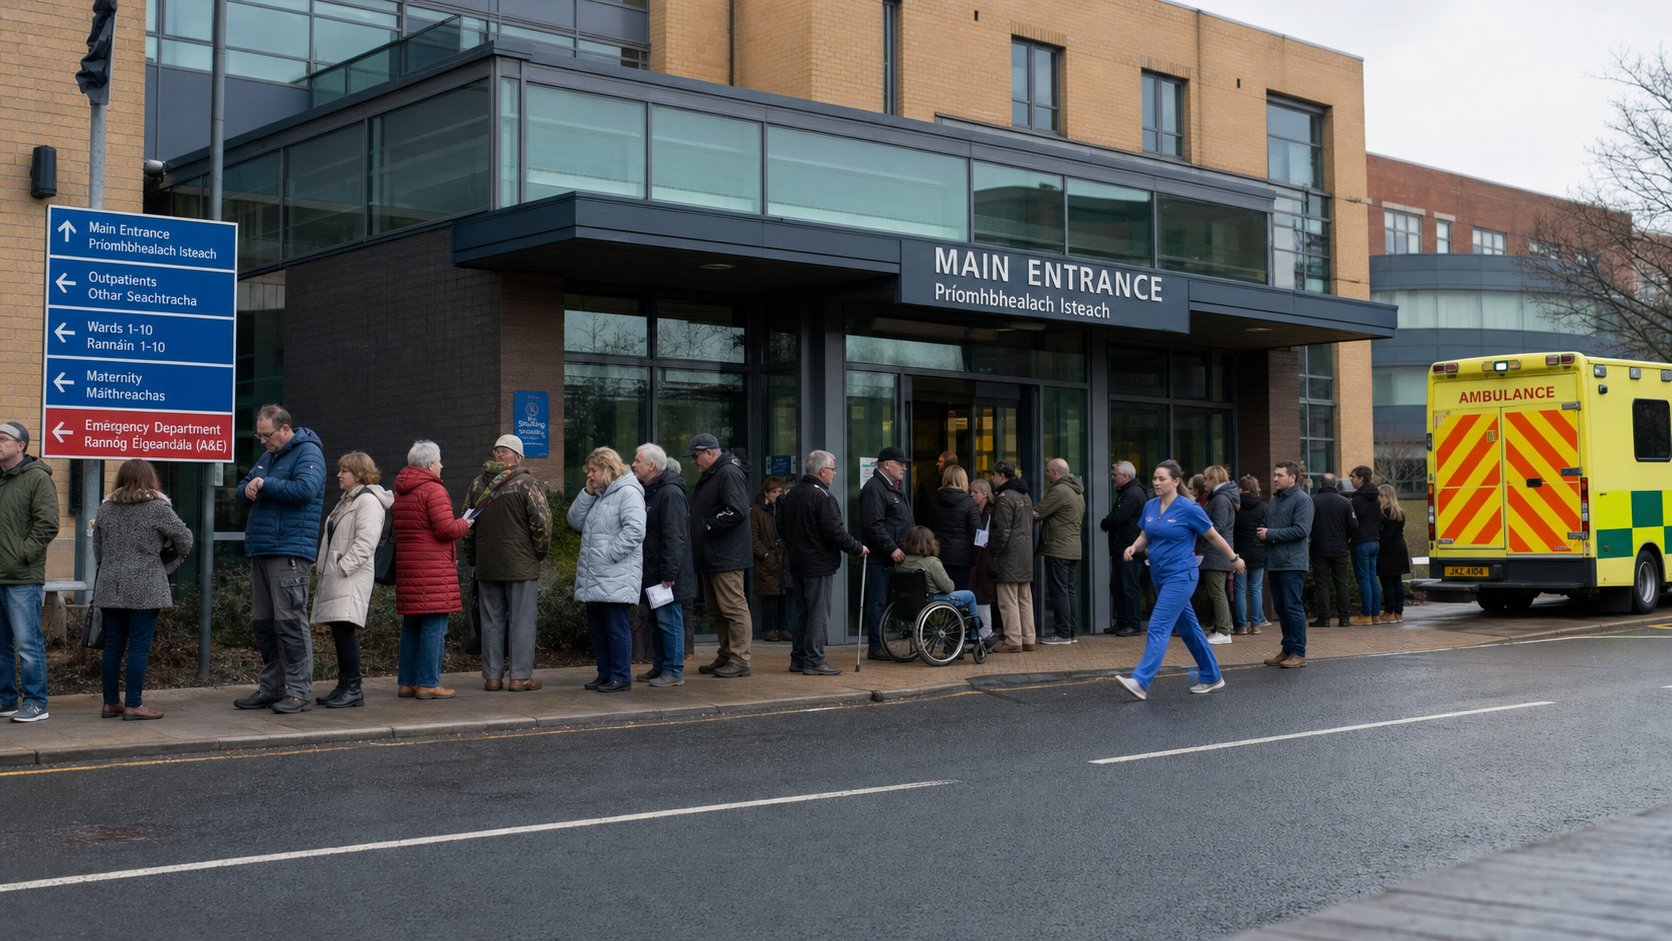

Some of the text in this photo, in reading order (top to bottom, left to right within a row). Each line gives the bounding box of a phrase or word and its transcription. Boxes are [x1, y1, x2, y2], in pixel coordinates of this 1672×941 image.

[89, 221, 170, 239] Main Entrance
[88, 238, 217, 260] Príomhbhealach Isteach
[88, 271, 157, 287] Outpatients
[935, 247, 1163, 302] MAIN ENTRANCE
[88, 287, 197, 306] Othar Seachtracha
[935, 283, 1110, 319] Príomhbhealach Isteach
[87, 320, 153, 336] Wards 1-10
[87, 337, 166, 353] Rannáin 1-10
[86, 370, 142, 386] Maternity
[86, 387, 166, 401] Máithreachas
[1459, 386, 1555, 404] AMBULANCE
[154, 421, 221, 436] Department
[84, 435, 127, 451] Rannóg
[196, 439, 227, 453] (A&E)
